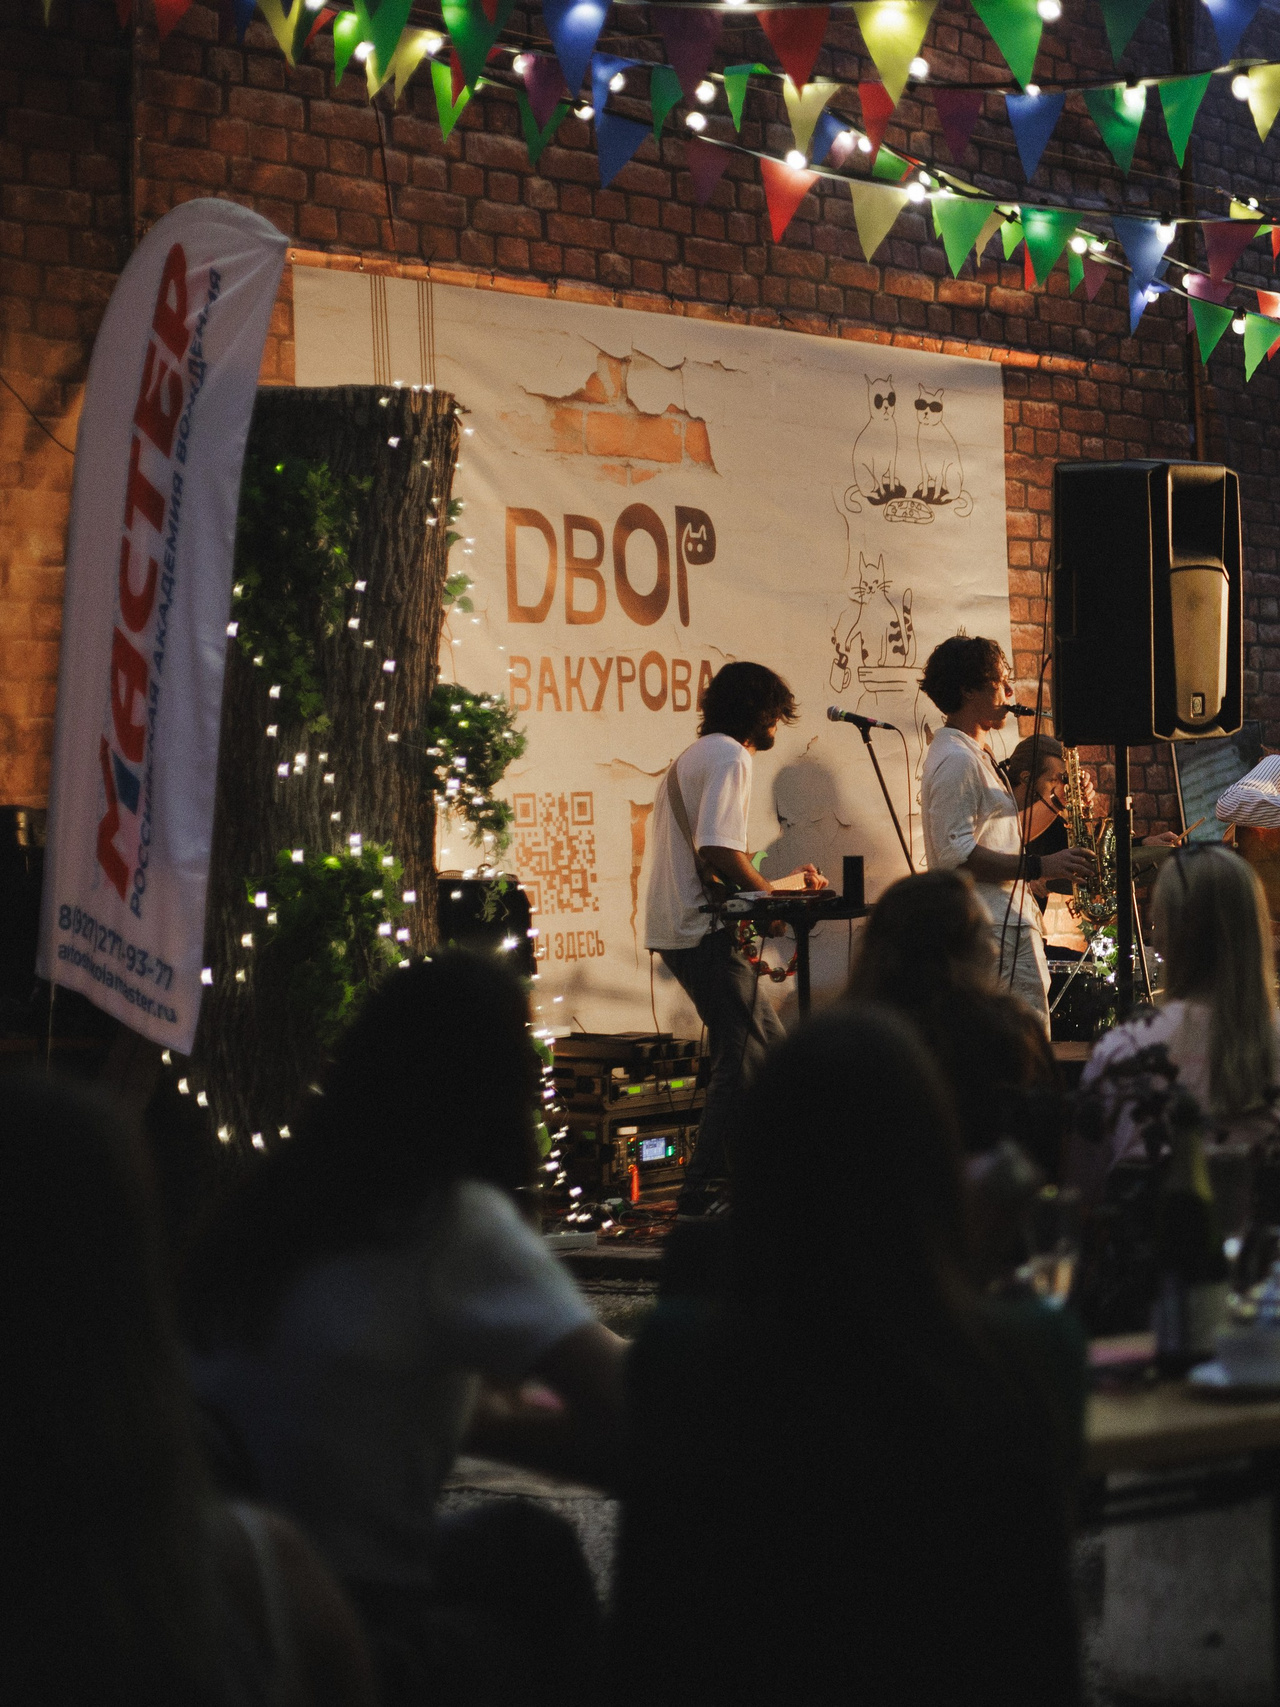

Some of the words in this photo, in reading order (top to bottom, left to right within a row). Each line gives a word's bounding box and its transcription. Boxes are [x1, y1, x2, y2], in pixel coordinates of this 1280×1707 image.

[97, 242, 189, 902] МАСТЕР
[153, 470, 184, 676] АКАДЕМИЯ
[554, 929, 605, 962] ЗДЕСЬ
